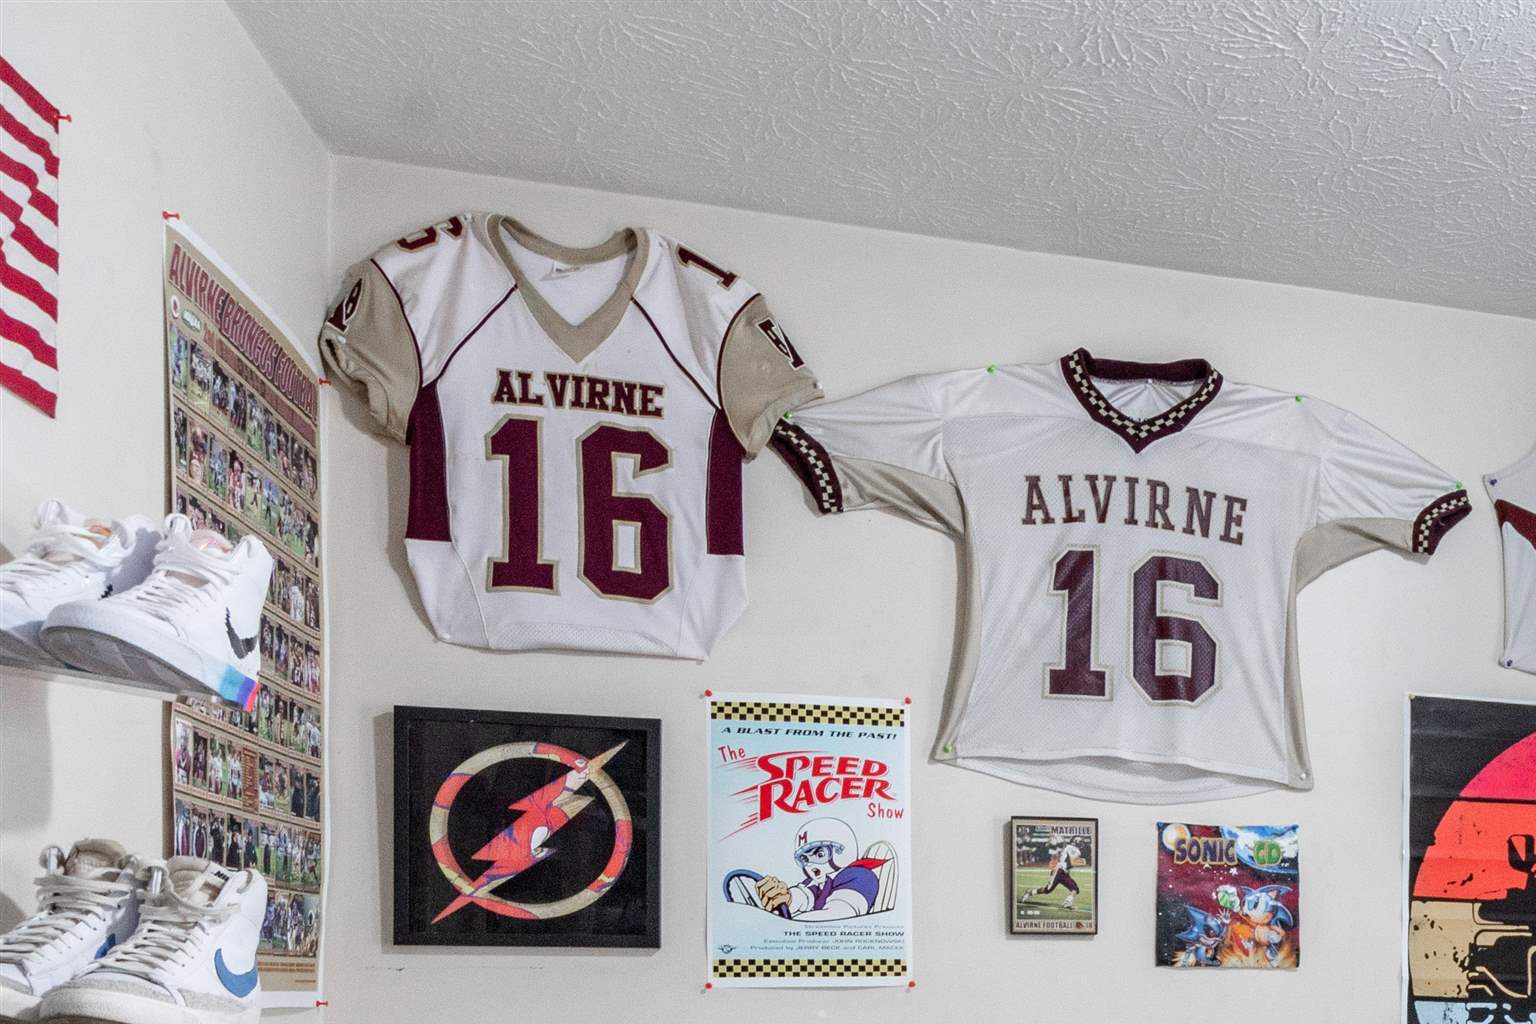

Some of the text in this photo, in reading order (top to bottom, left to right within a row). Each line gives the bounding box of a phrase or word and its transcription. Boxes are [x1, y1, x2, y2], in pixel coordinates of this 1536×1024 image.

[169, 242, 227, 326] ALVIRNE
[491, 367, 665, 419] ALVIRNE
[483, 413, 675, 605] 16
[1022, 474, 1248, 546] ALVIRNE
[1040, 542, 1224, 709] 16
[736, 727, 781, 736] BLAST
[785, 729, 824, 738] FROM
[828, 730, 852, 739] THE
[857, 732, 898, 741] PAST!
[718, 745, 746, 763] The
[757, 750, 889, 781] SPEED
[758, 776, 897, 822] RACER
[867, 802, 905, 819] Show
[798, 831, 809, 844] M
[1174, 836, 1281, 866] SONIC CD
